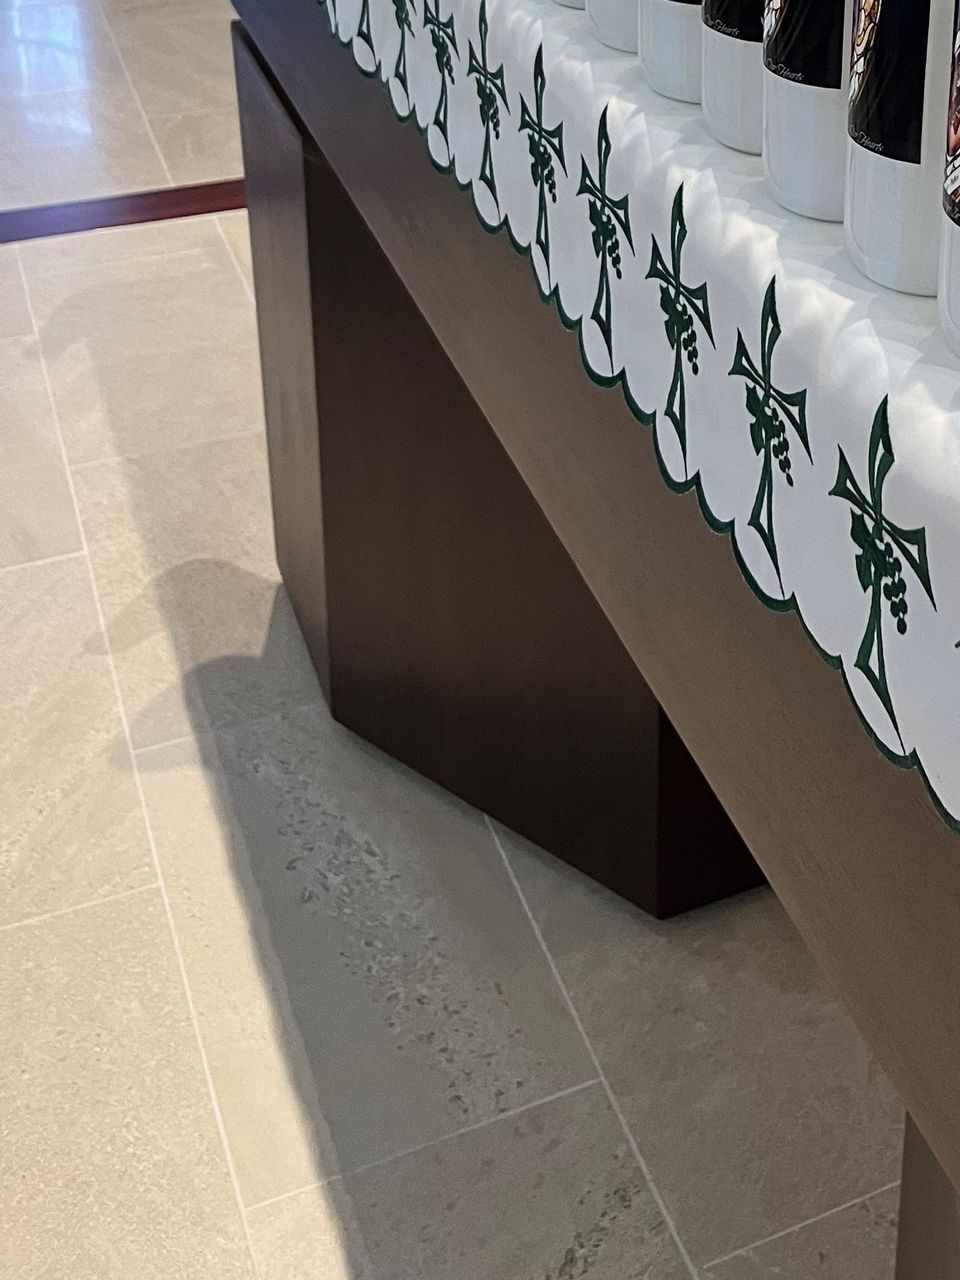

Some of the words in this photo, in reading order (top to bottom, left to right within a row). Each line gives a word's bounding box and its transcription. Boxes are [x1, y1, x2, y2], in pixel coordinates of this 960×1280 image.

[714, 19, 740, 36] Hearts
[776, 63, 804, 81] Hearts
[858, 131, 885, 151] Hearts
